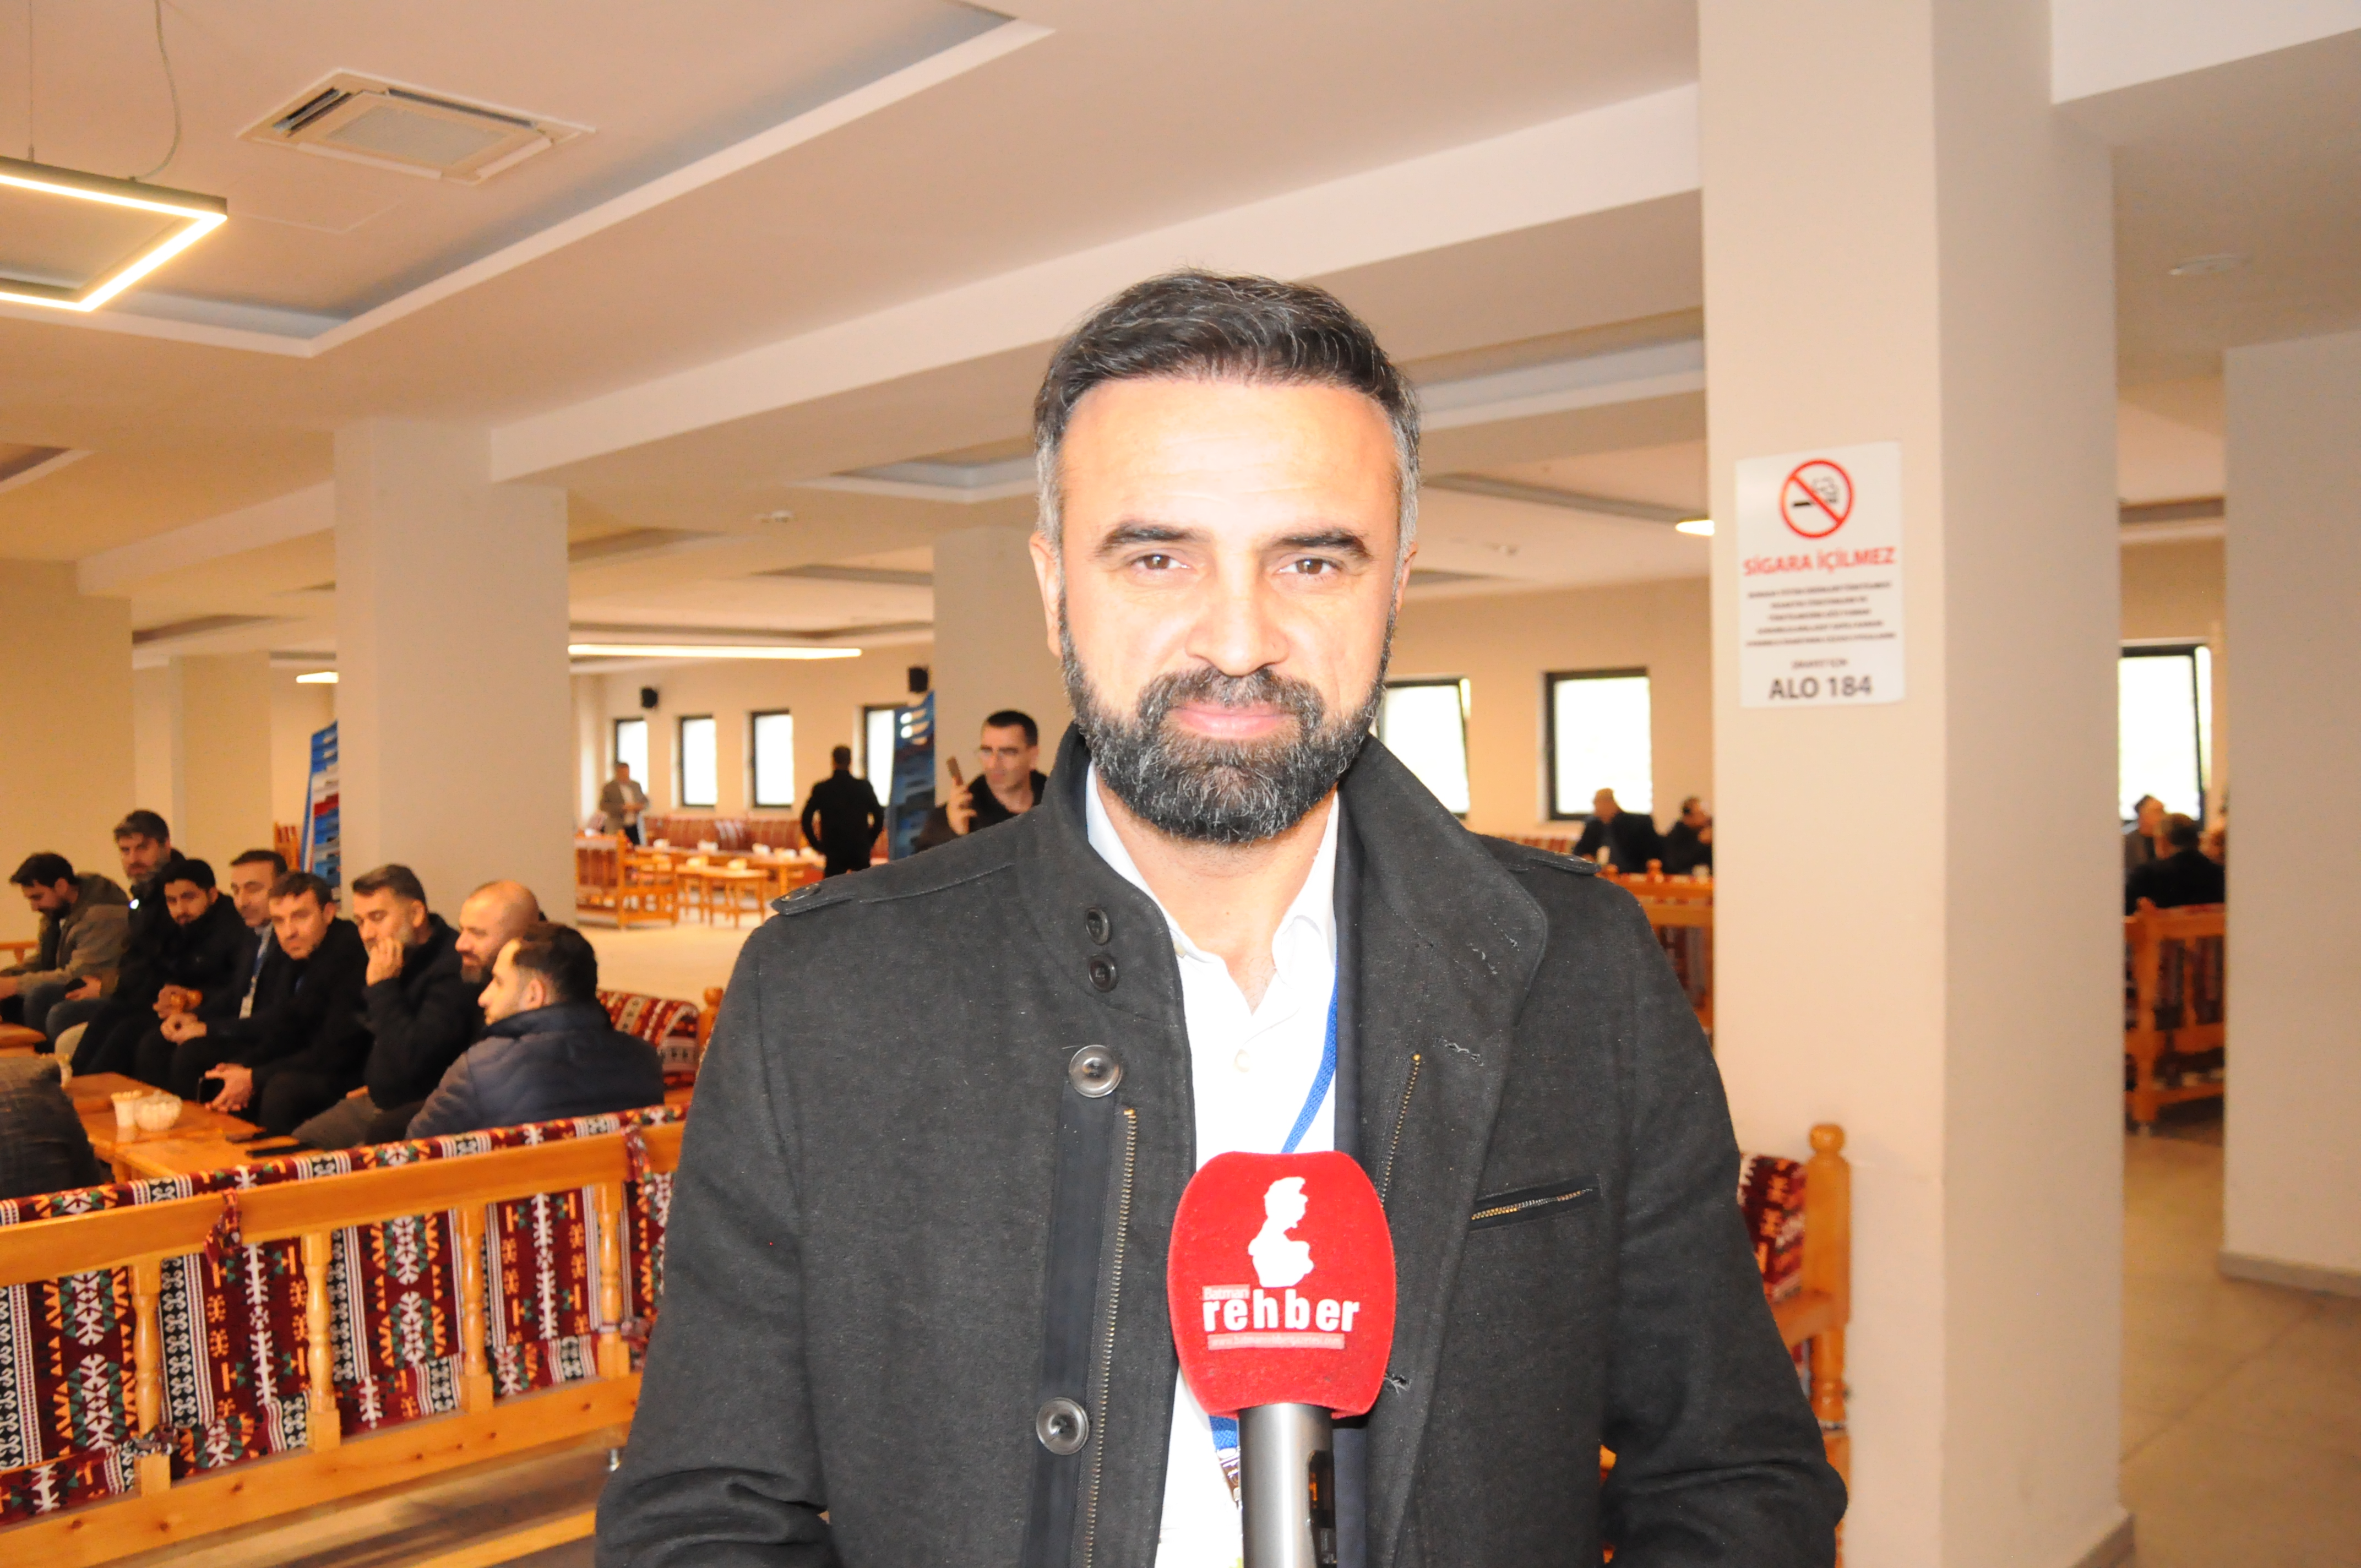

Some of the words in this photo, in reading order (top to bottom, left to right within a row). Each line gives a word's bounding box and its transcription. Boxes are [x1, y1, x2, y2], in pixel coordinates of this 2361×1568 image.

[1769, 678, 1820, 699] ALO
[1828, 675, 1873, 697] 184
[1204, 1287, 1249, 1300] Batman
[1203, 1288, 1360, 1332] rehber
